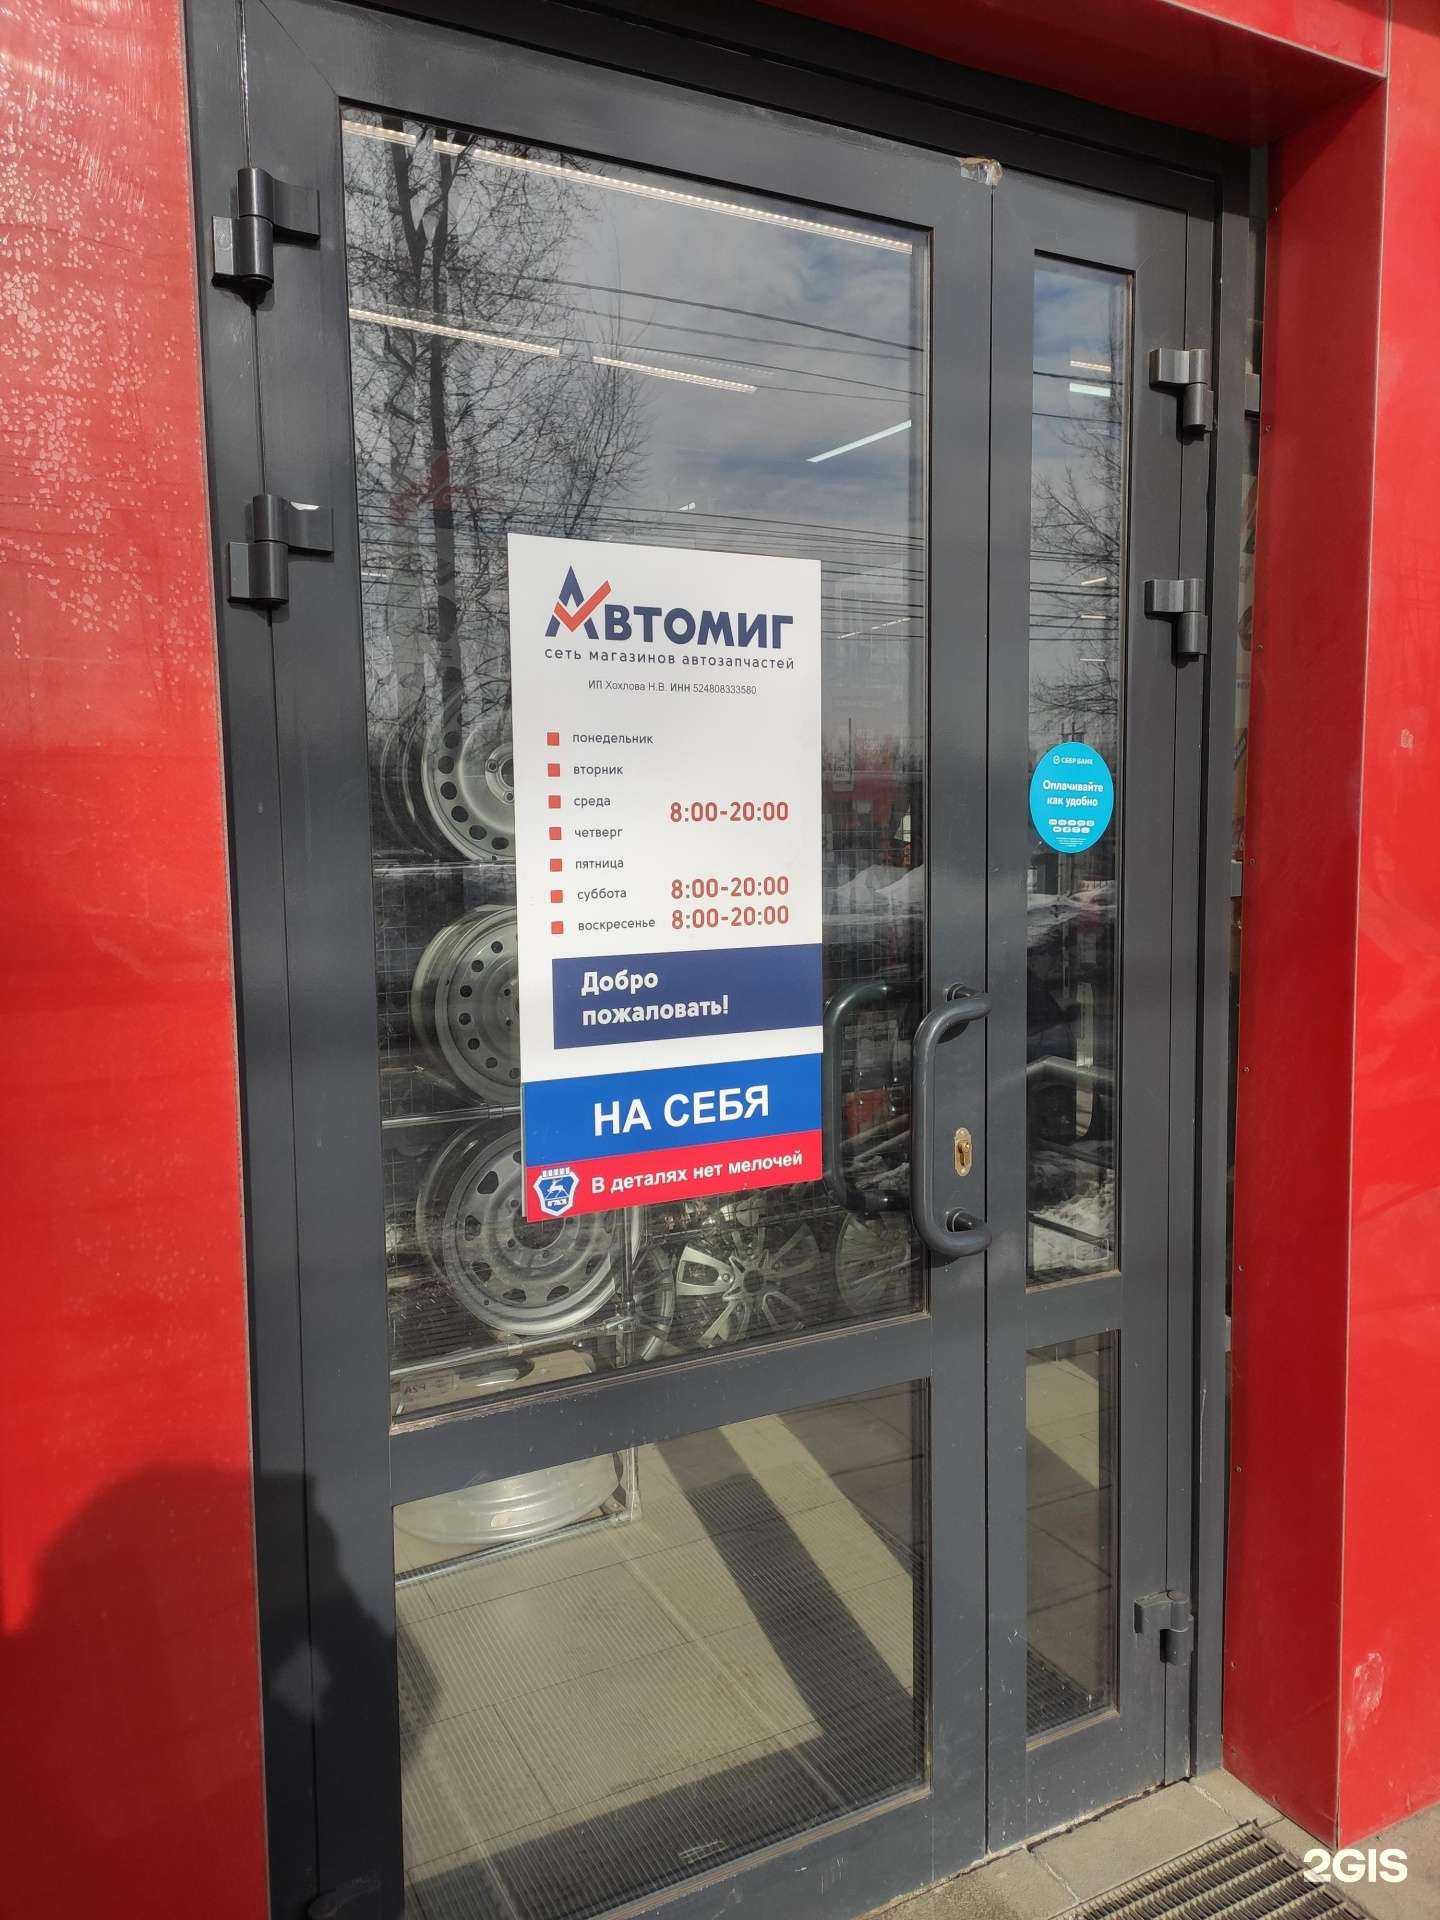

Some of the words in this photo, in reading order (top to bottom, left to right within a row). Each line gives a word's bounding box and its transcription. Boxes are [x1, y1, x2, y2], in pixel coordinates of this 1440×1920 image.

[544, 648, 581, 660] сеть
[589, 650, 675, 665] магазинов
[682, 654, 794, 669] автозапчастей
[588, 680, 603, 689] ИП
[605, 681, 645, 691] Хохлова
[670, 683, 691, 693] ИНН
[572, 733, 655, 744] понедельник
[573, 765, 624, 777] вторник
[1042, 780, 1104, 792] Оплачивайте
[573, 796, 611, 808] среда
[1047, 797, 1063, 805] как
[1065, 796, 1098, 807] удобно
[670, 801, 789, 822] 8:00-20:00
[574, 827, 623, 838] четверг
[575, 858, 624, 870] пятница
[577, 888, 627, 902] суббота
[671, 876, 789, 899] 8:00-20:00
[578, 918, 656, 931] воскресенье
[671, 905, 789, 930] 8:00-20:00
[580, 970, 659, 996] Добро
[582, 995, 729, 1026] пожаловать!
[594, 1099, 652, 1136] НА
[664, 1084, 769, 1128] СЕБЯ
[591, 1177, 605, 1194] В
[611, 1170, 688, 1193] деталях
[693, 1162, 723, 1179] нет
[728, 1150, 803, 1175] мелочей
